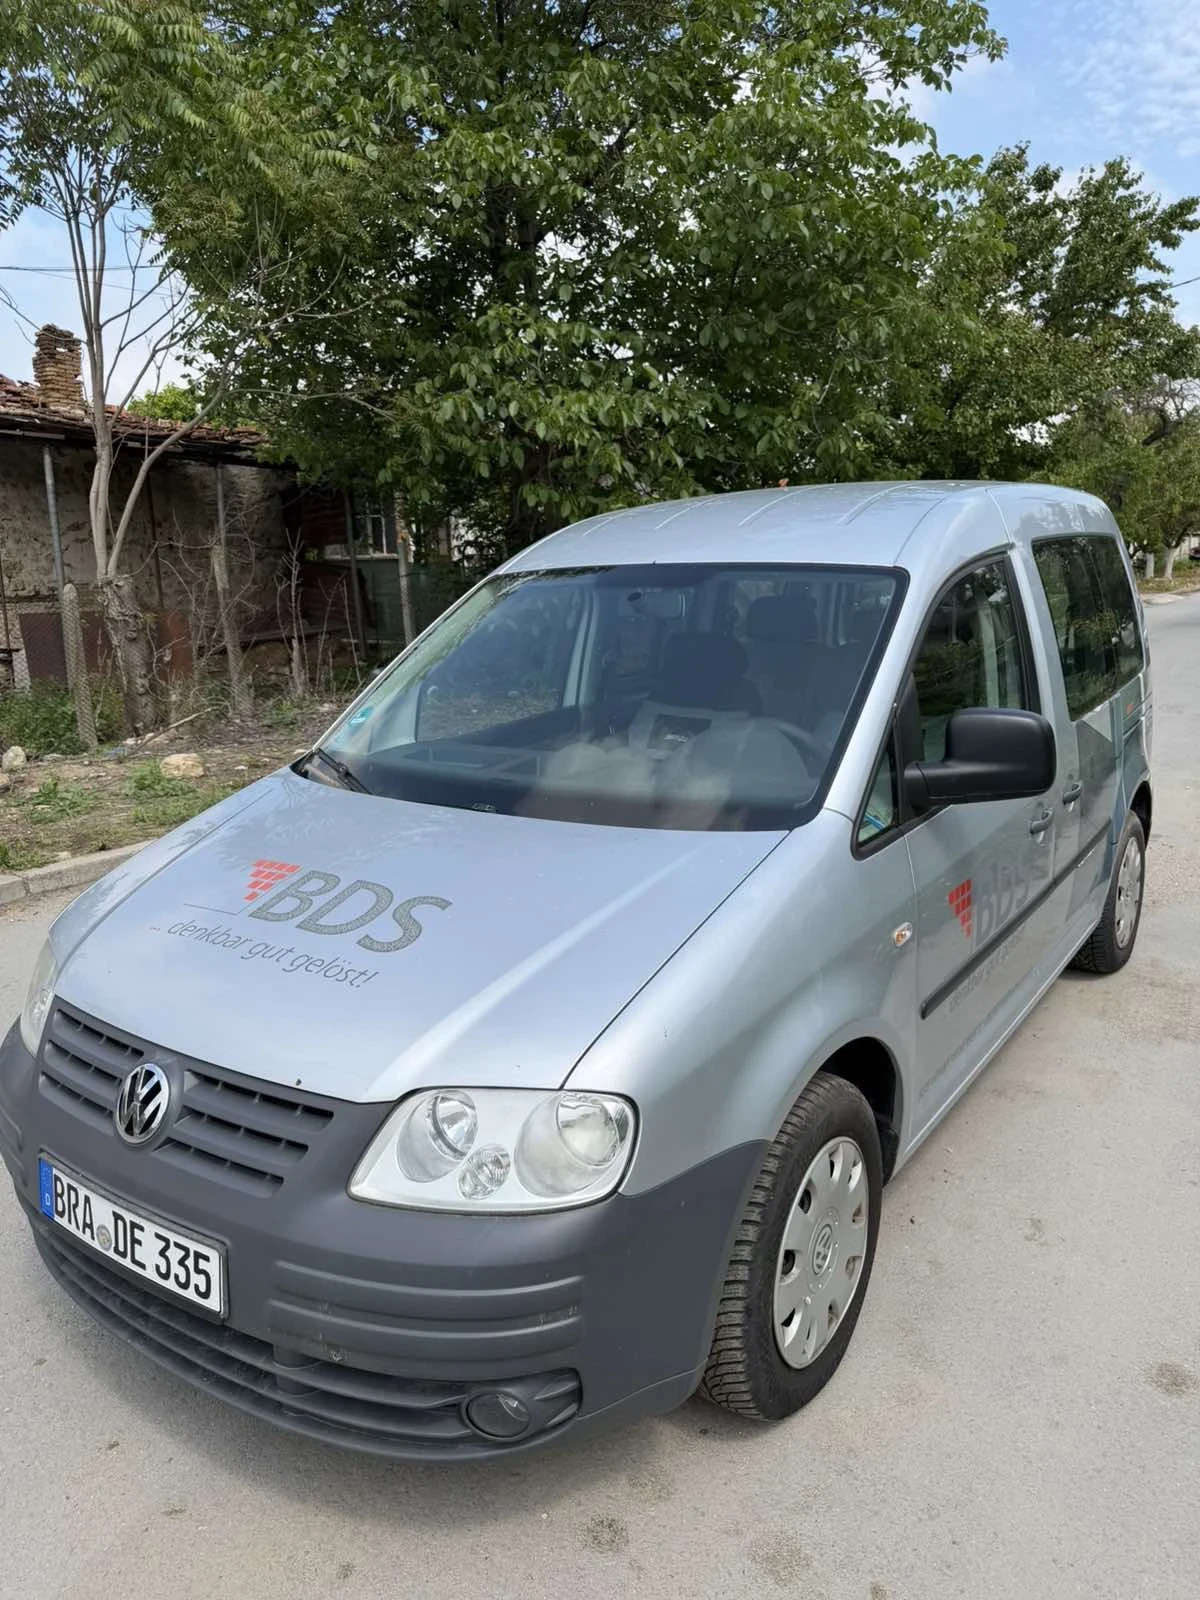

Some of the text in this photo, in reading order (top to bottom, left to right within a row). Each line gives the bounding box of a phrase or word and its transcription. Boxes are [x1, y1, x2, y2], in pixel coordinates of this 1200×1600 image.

[248, 869, 453, 953] BDS
[167, 919, 253, 950] denkbar
[240, 940, 296, 960] gut
[281, 951, 380, 988] gelöst!
[54, 1174, 212, 1300] BRA DE 335
